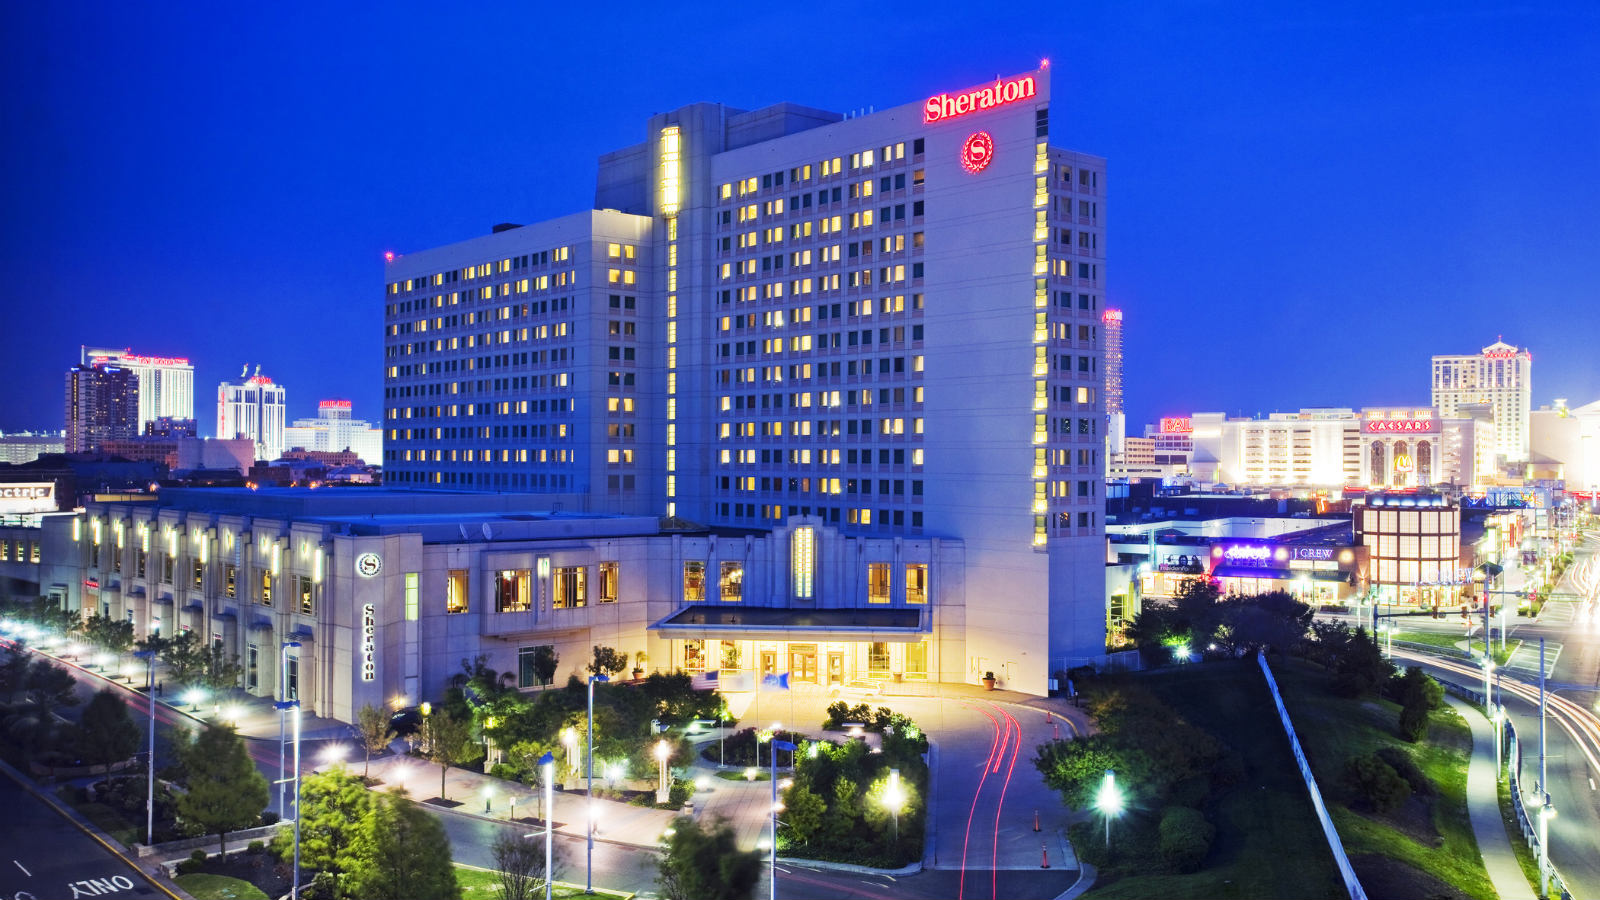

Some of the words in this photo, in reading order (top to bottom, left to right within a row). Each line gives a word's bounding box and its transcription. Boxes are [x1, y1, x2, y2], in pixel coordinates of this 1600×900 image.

[925, 77, 1035, 122] Sheraton
[970, 139, 986, 161] S
[1369, 421, 1431, 430] CAESARS
[1300, 549, 1333, 559] CREW
[364, 604, 375, 680] Sheraton
[68, 875, 134, 899] ONLY
